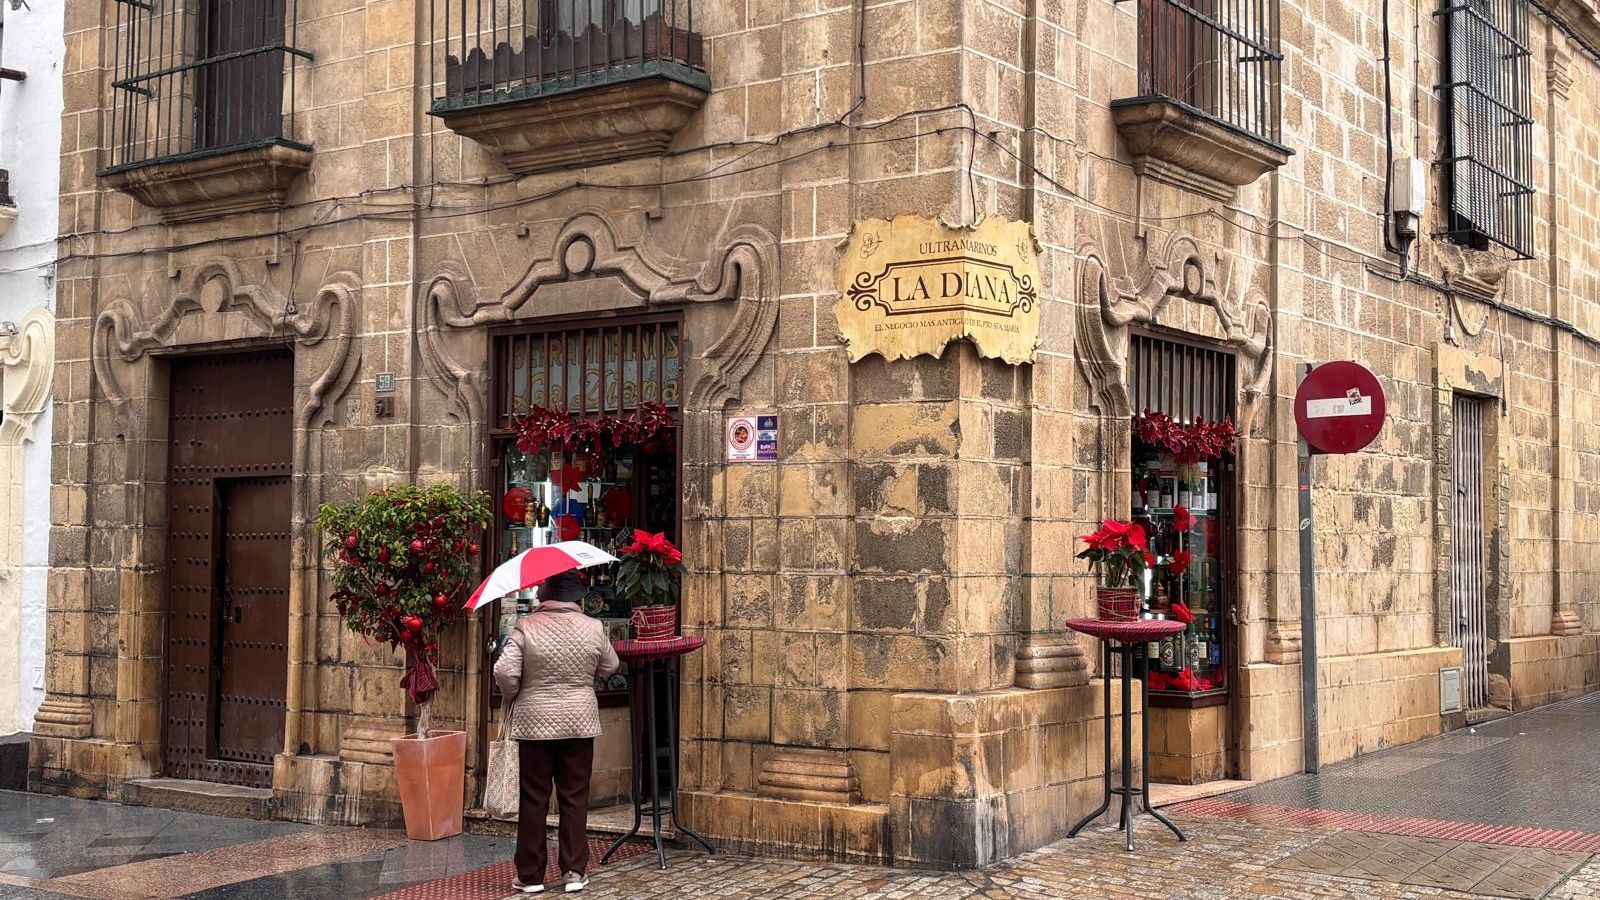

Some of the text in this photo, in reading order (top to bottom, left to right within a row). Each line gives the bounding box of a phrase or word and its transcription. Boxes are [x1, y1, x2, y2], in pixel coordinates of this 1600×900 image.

[919, 238, 998, 257] ULTRAMARINOS
[892, 271, 1012, 304] LA DIANA
[874, 323, 884, 331] EL
[885, 321, 918, 330] NEGOCIO
[379, 375, 390, 389] 59
